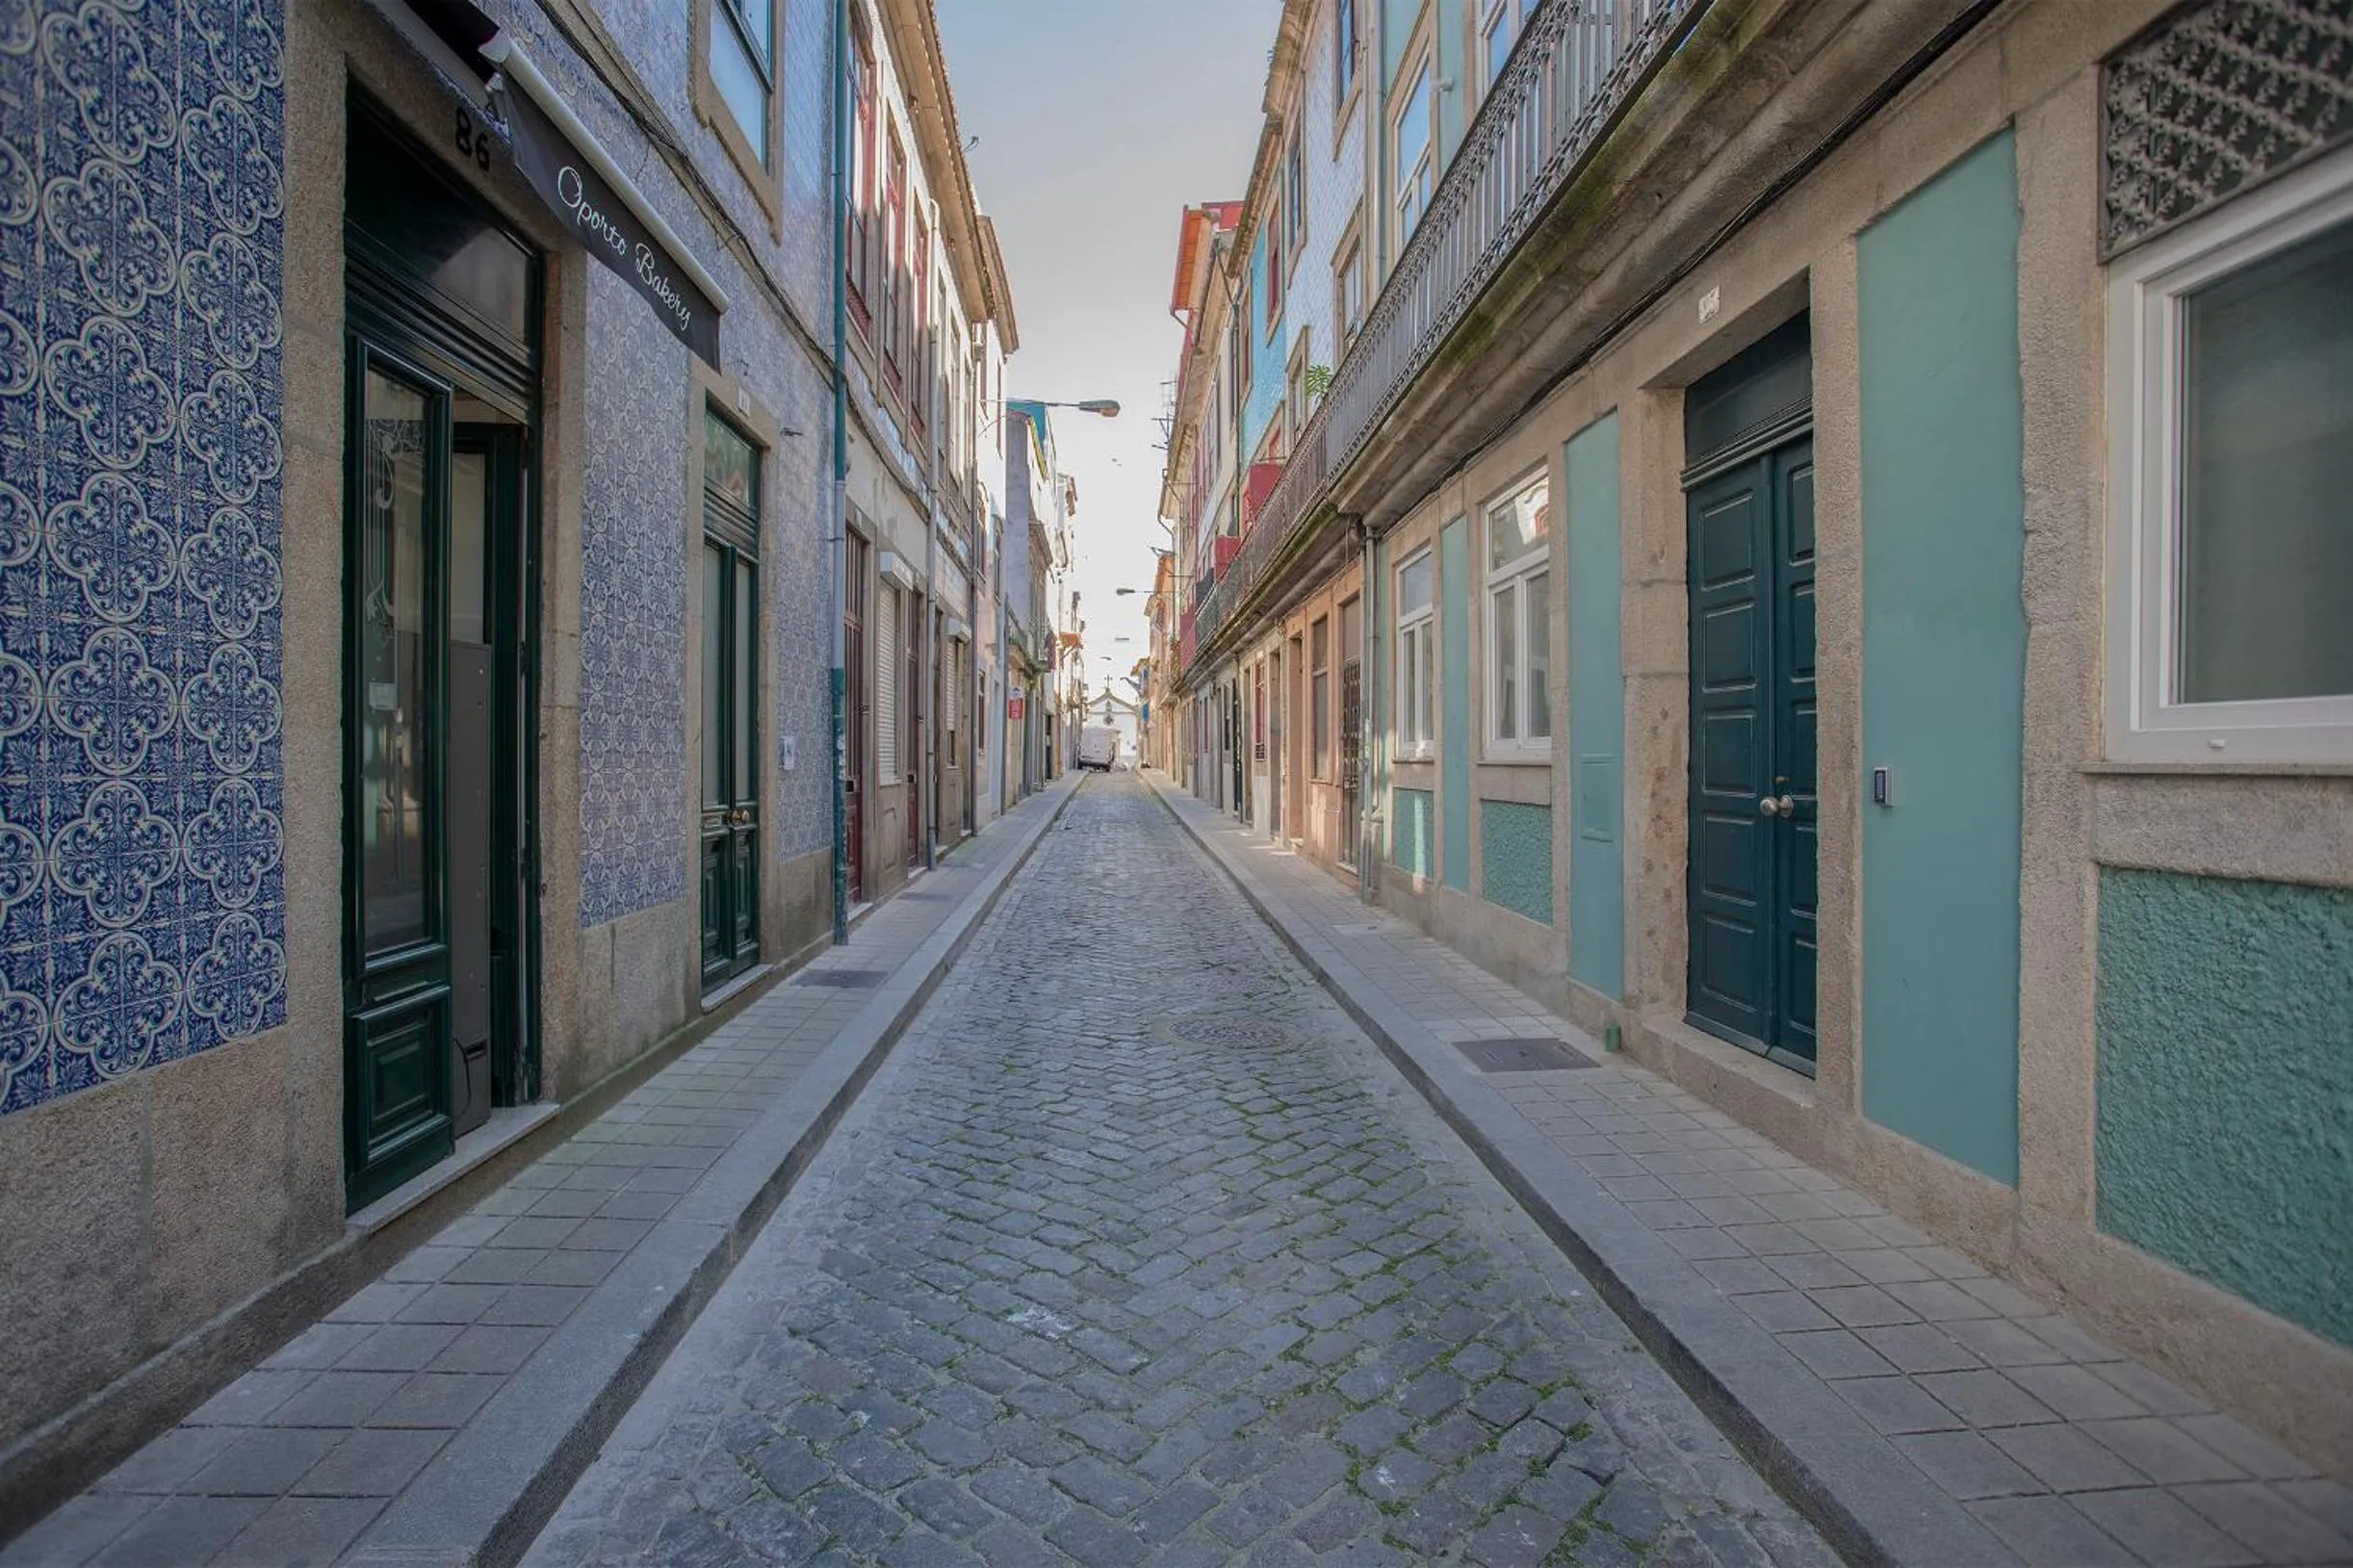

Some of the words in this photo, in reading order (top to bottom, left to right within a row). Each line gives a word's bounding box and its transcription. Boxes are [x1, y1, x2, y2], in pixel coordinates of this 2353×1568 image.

[456, 107, 490, 172] 86
[557, 166, 627, 255] Oporto
[634, 242, 692, 331] Bakery
